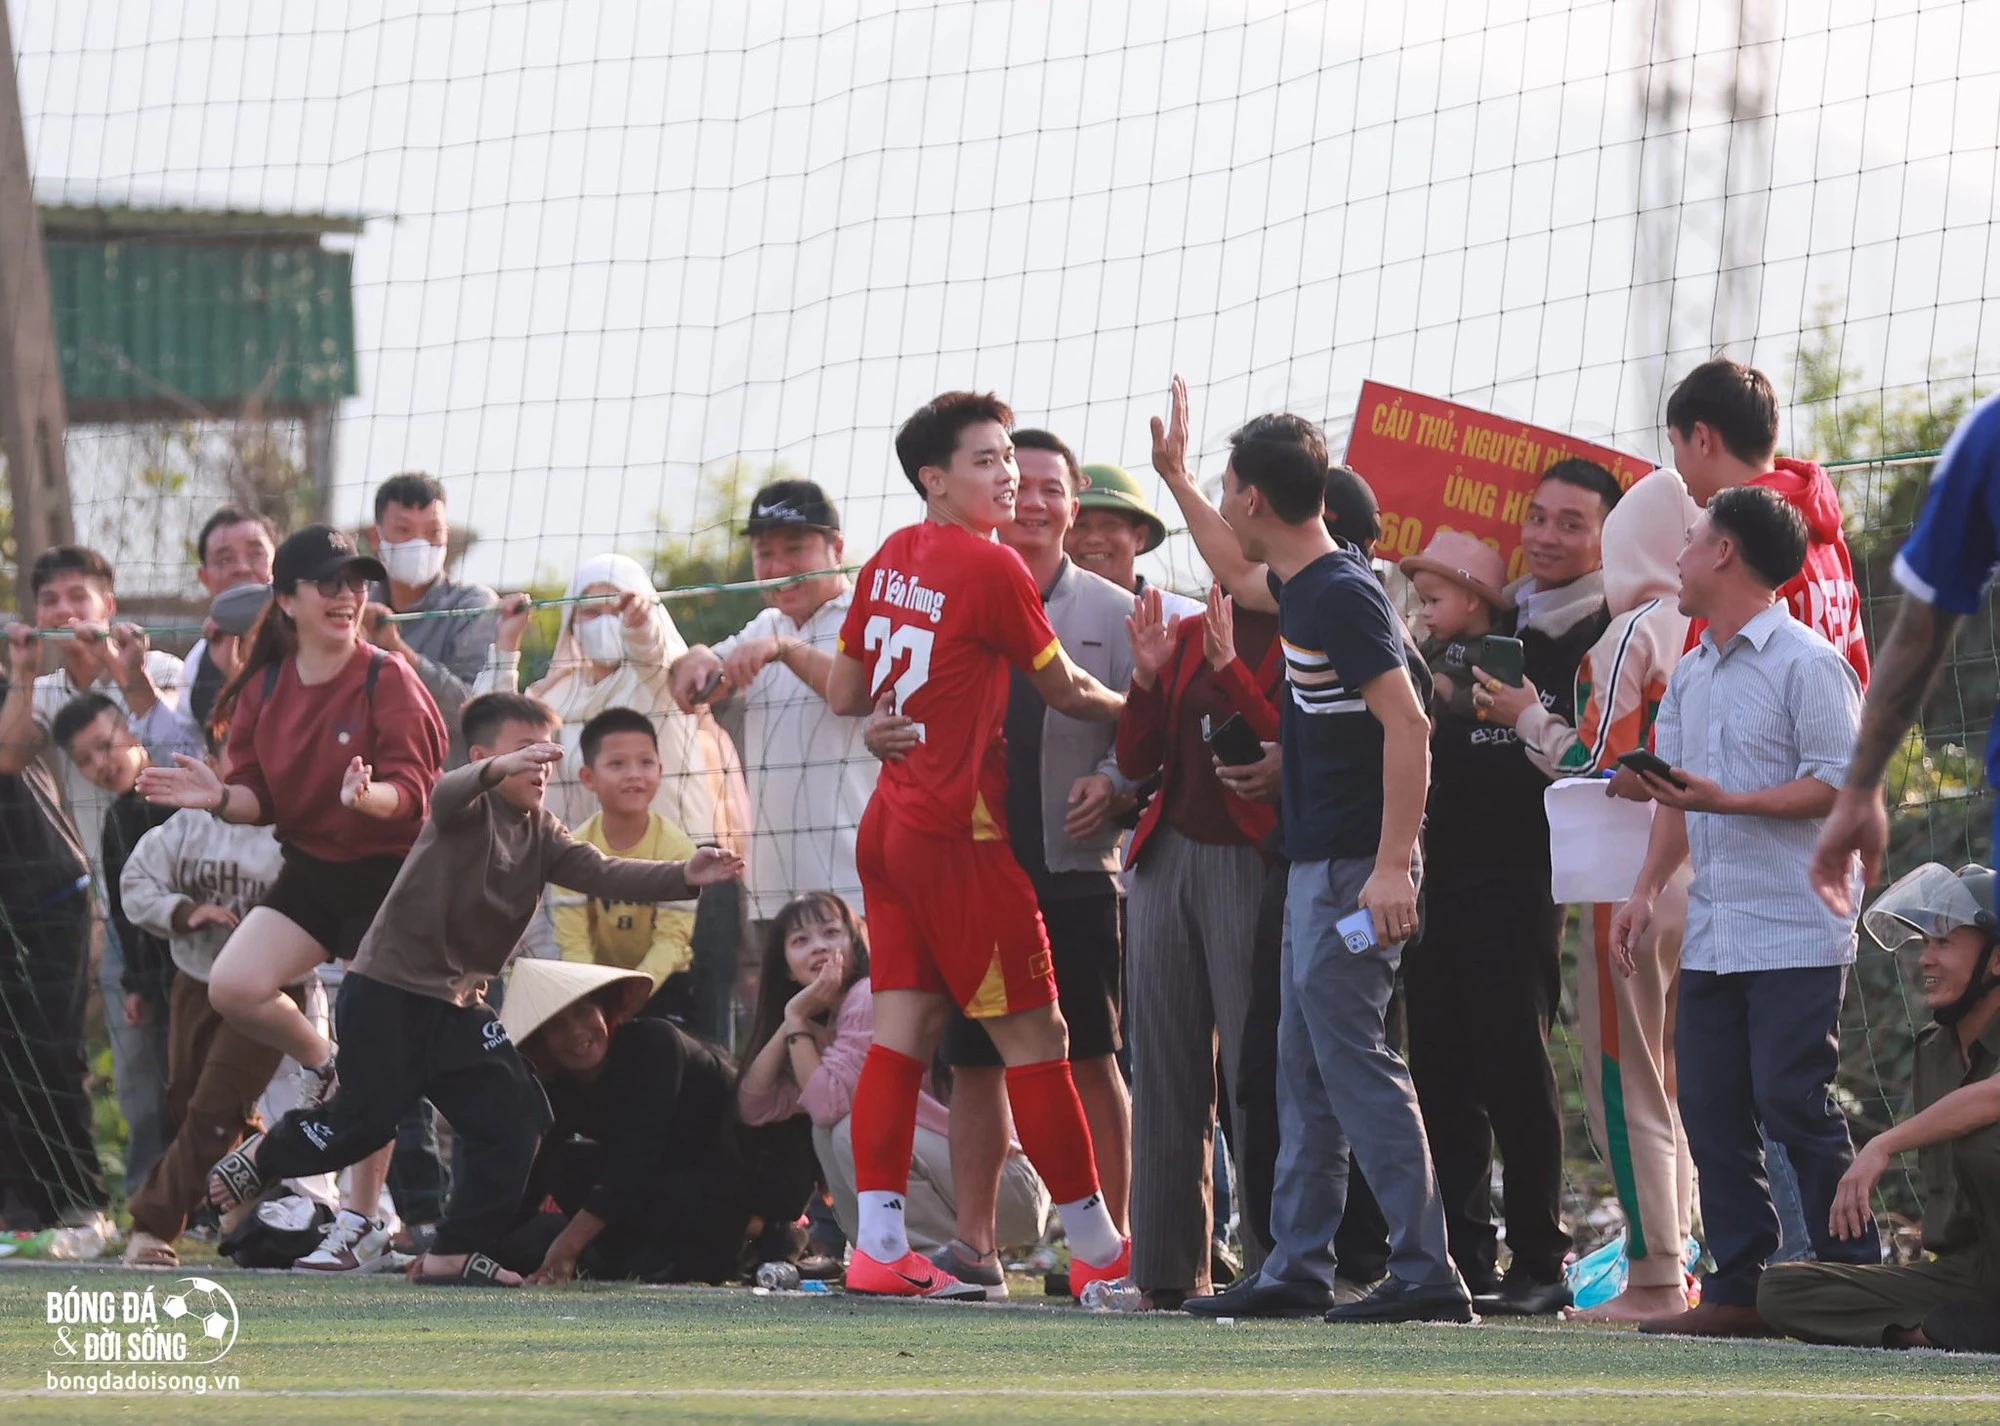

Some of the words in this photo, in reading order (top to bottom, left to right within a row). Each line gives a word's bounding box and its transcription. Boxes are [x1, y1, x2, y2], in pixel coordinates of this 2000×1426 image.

[1371, 396, 1414, 441] CẦU
[1416, 409, 1459, 453] THỦ:
[1461, 426, 1541, 474] NGUYỄN
[904, 575, 945, 624] Trung
